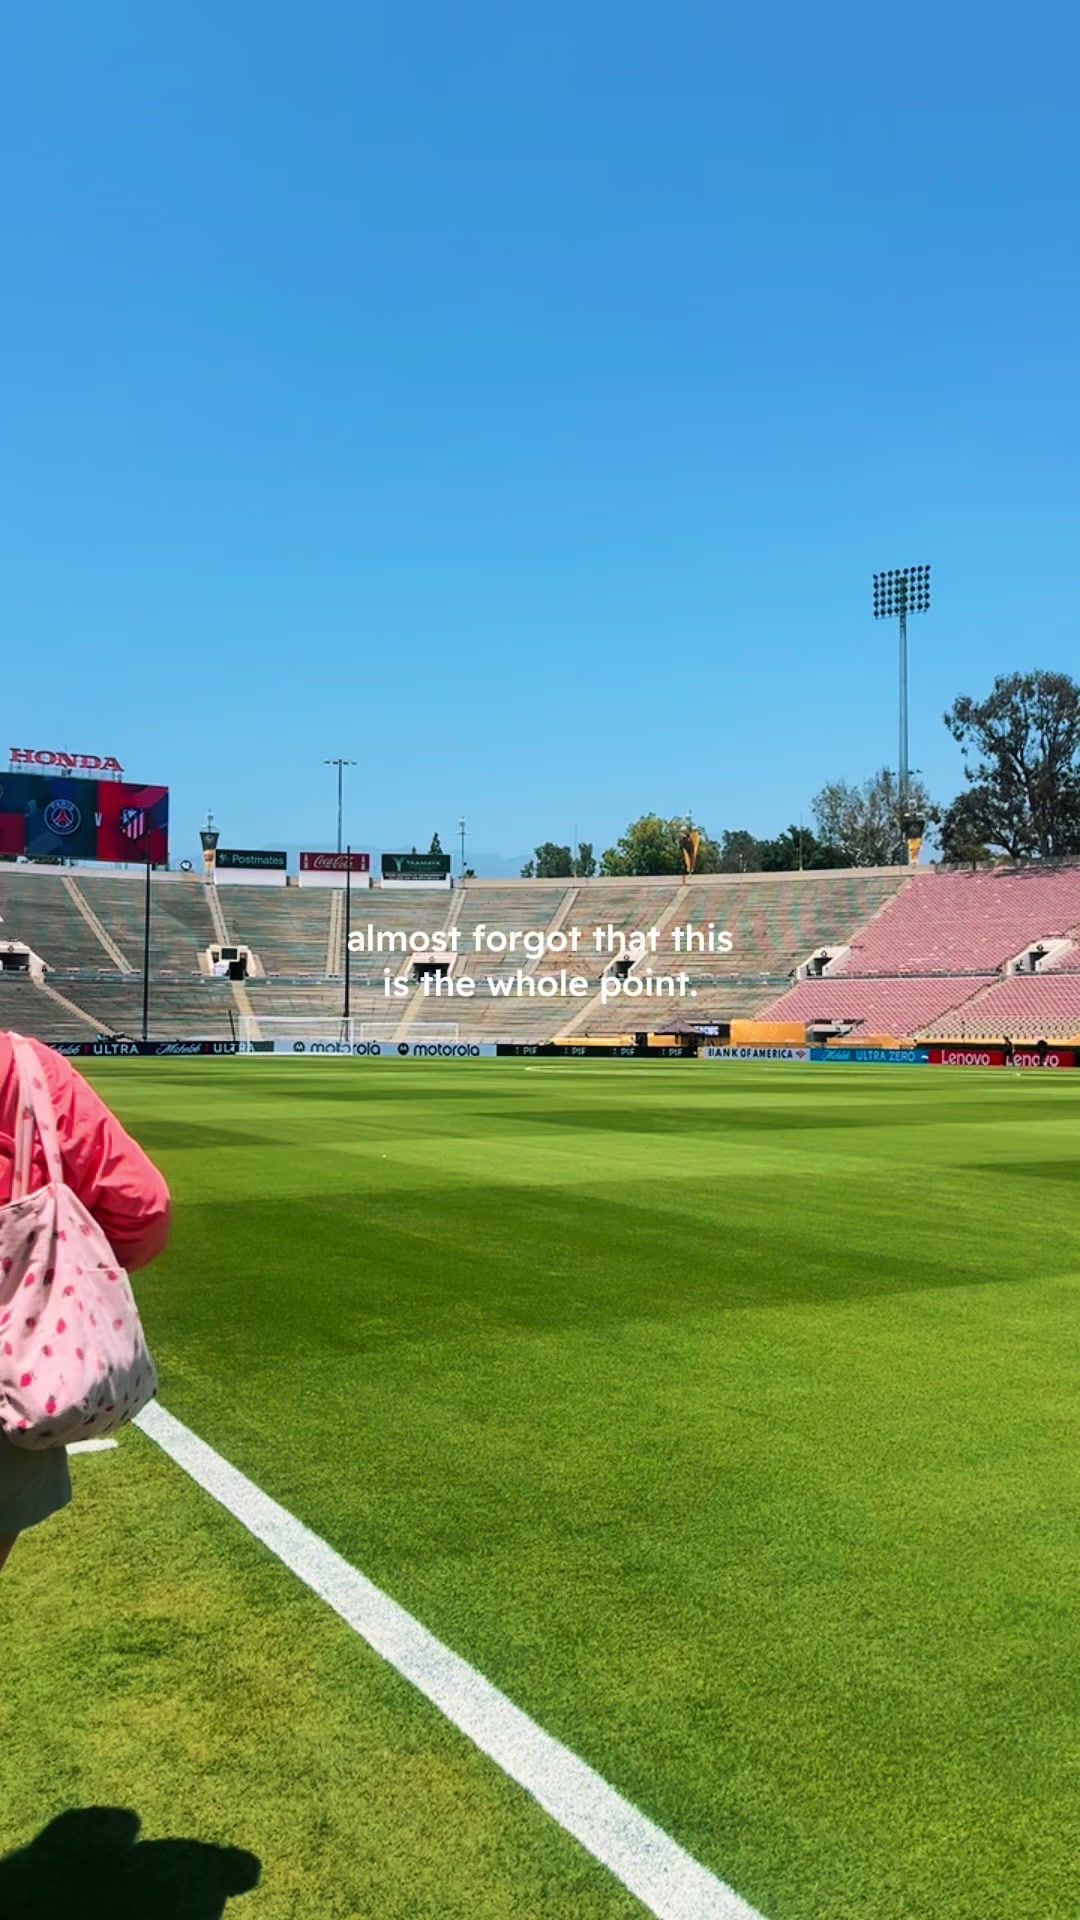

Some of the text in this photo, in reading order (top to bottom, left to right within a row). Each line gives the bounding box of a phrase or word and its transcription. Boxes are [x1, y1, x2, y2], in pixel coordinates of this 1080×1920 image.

[9, 747, 125, 772] HONDA
[232, 853, 284, 866] Postmates
[93, 1043, 139, 1055] ULTRA
[413, 1043, 480, 1056] motorola
[708, 1047, 793, 1059] BANK OF AMERICA
[856, 1050, 886, 1061] ULTRA
[889, 1051, 916, 1062] ZERO
[941, 1050, 991, 1066] Lenovo
